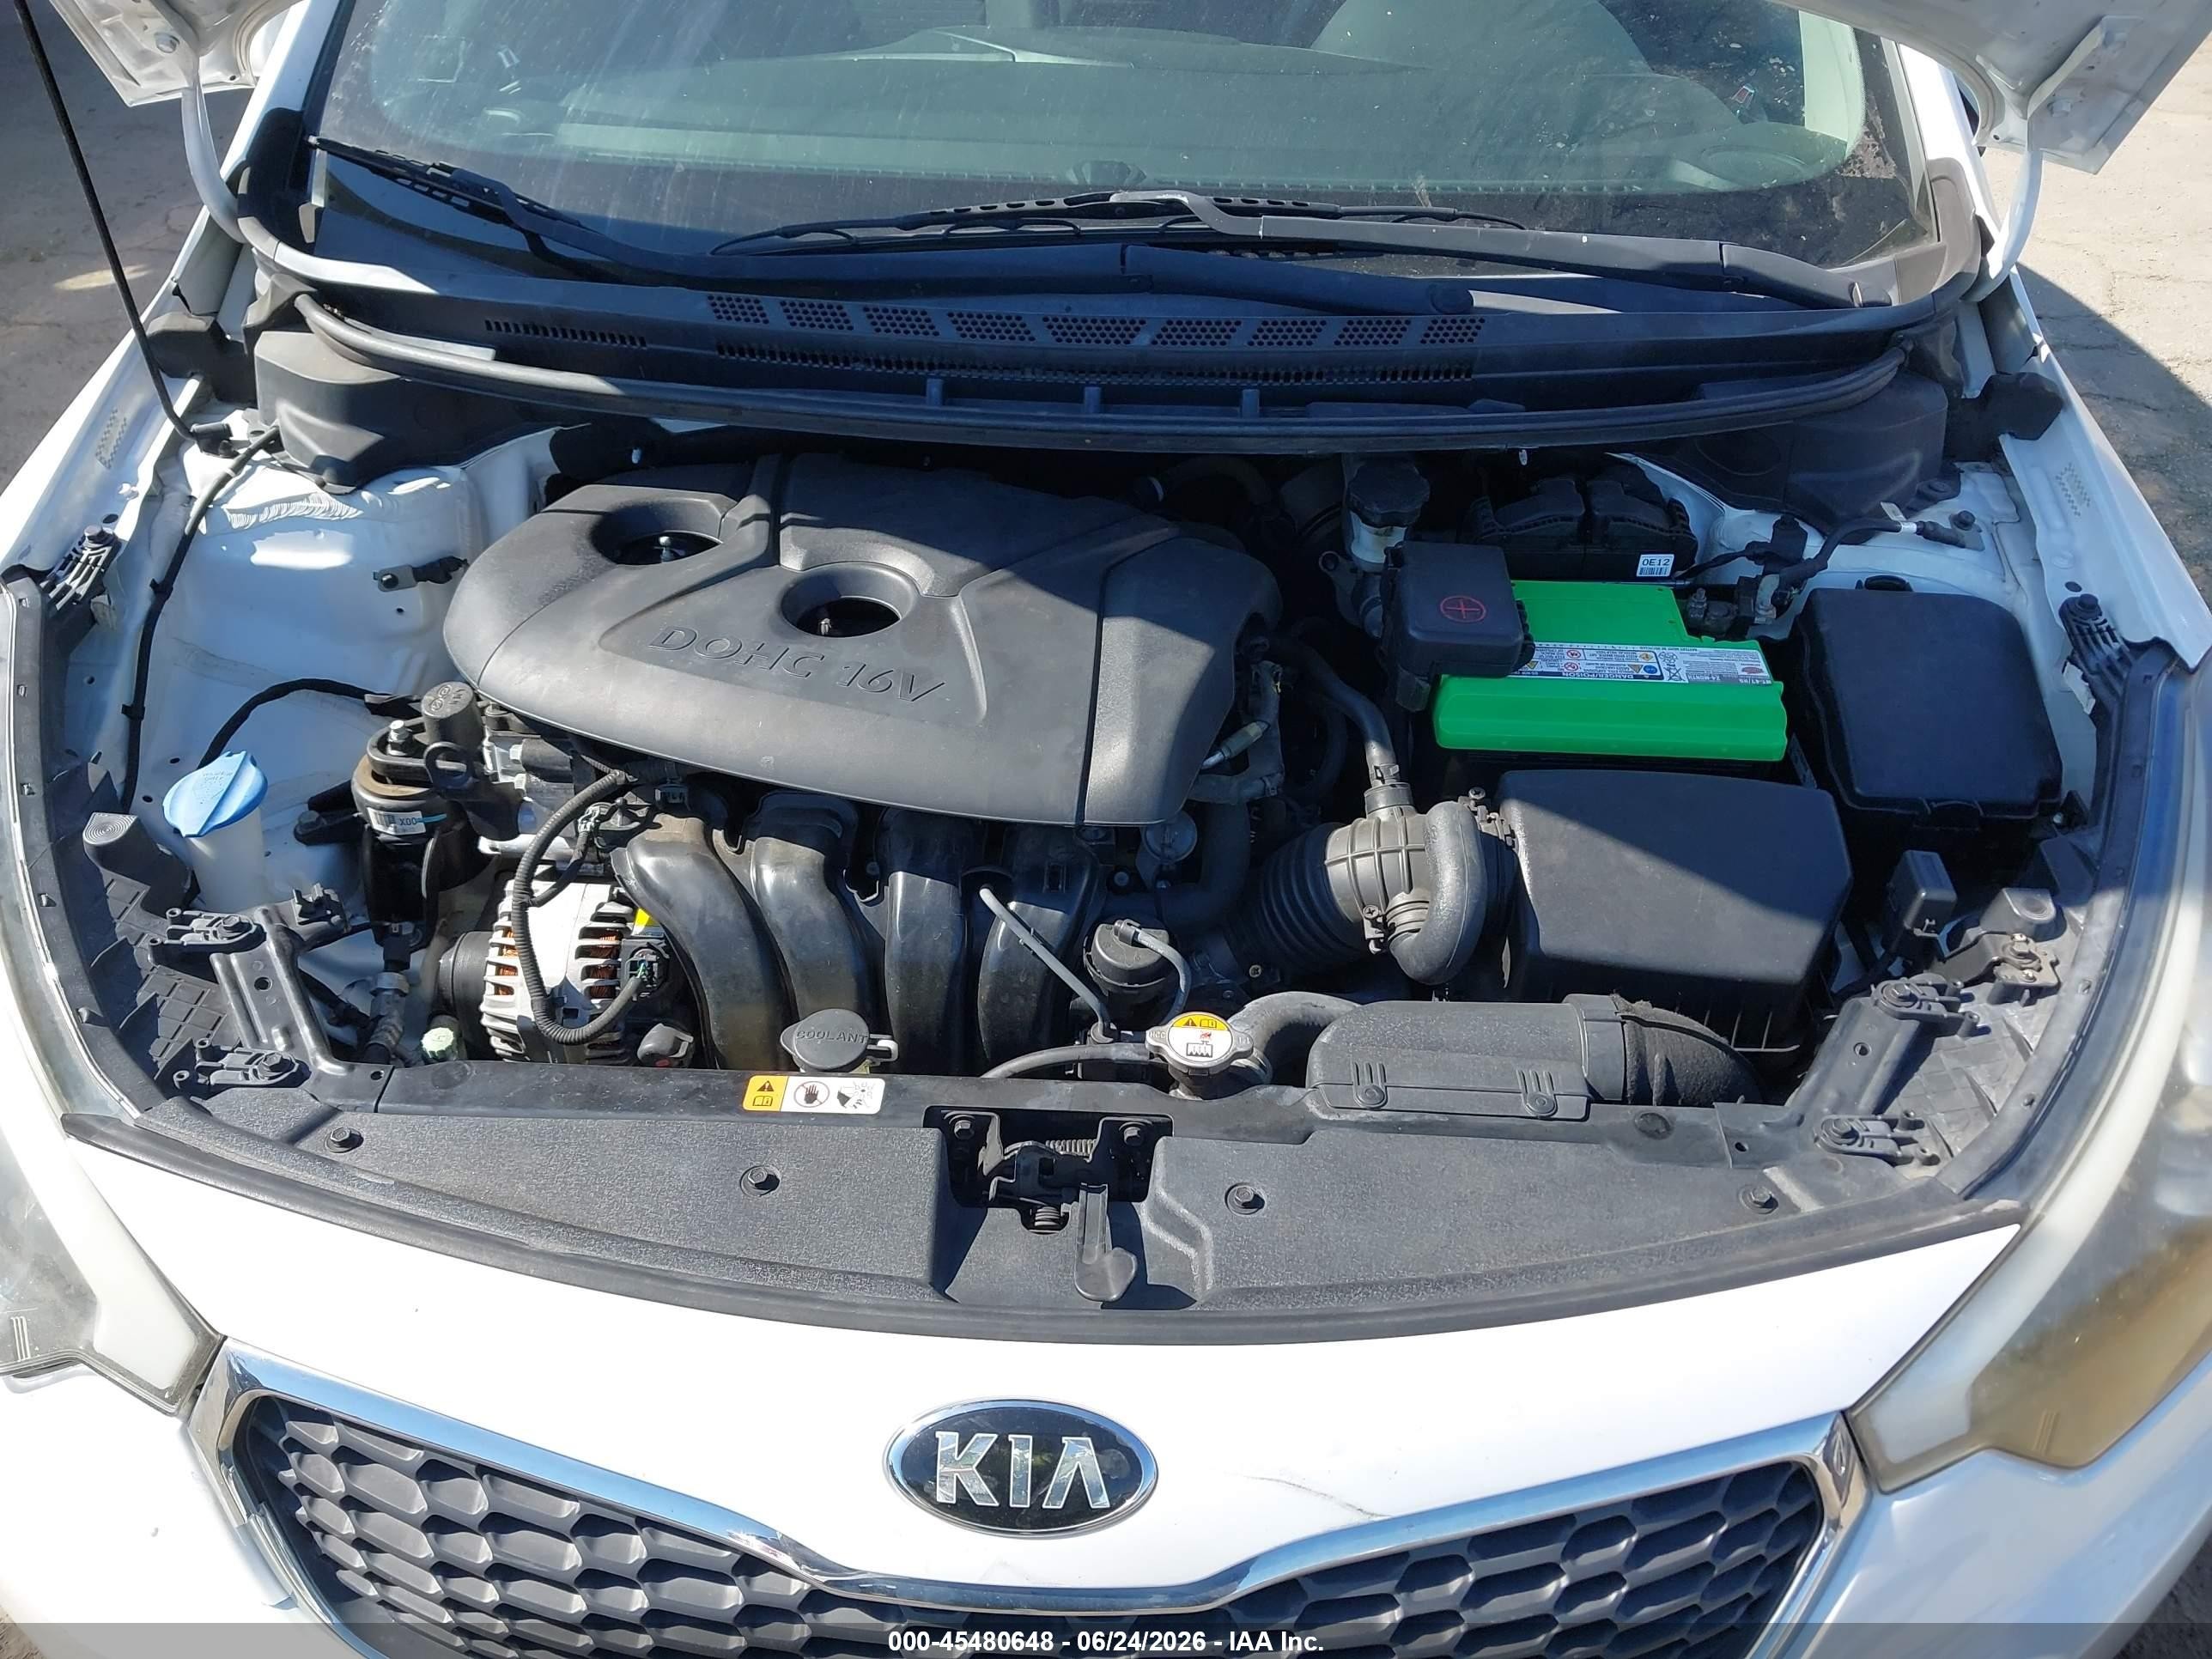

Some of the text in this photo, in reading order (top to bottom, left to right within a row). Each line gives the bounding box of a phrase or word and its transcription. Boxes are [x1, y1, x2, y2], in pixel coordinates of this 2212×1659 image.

[648, 625, 946, 702] DOHC 16V
[796, 1030, 868, 1044] COOLANT
[935, 1431, 1110, 1509] KIA
